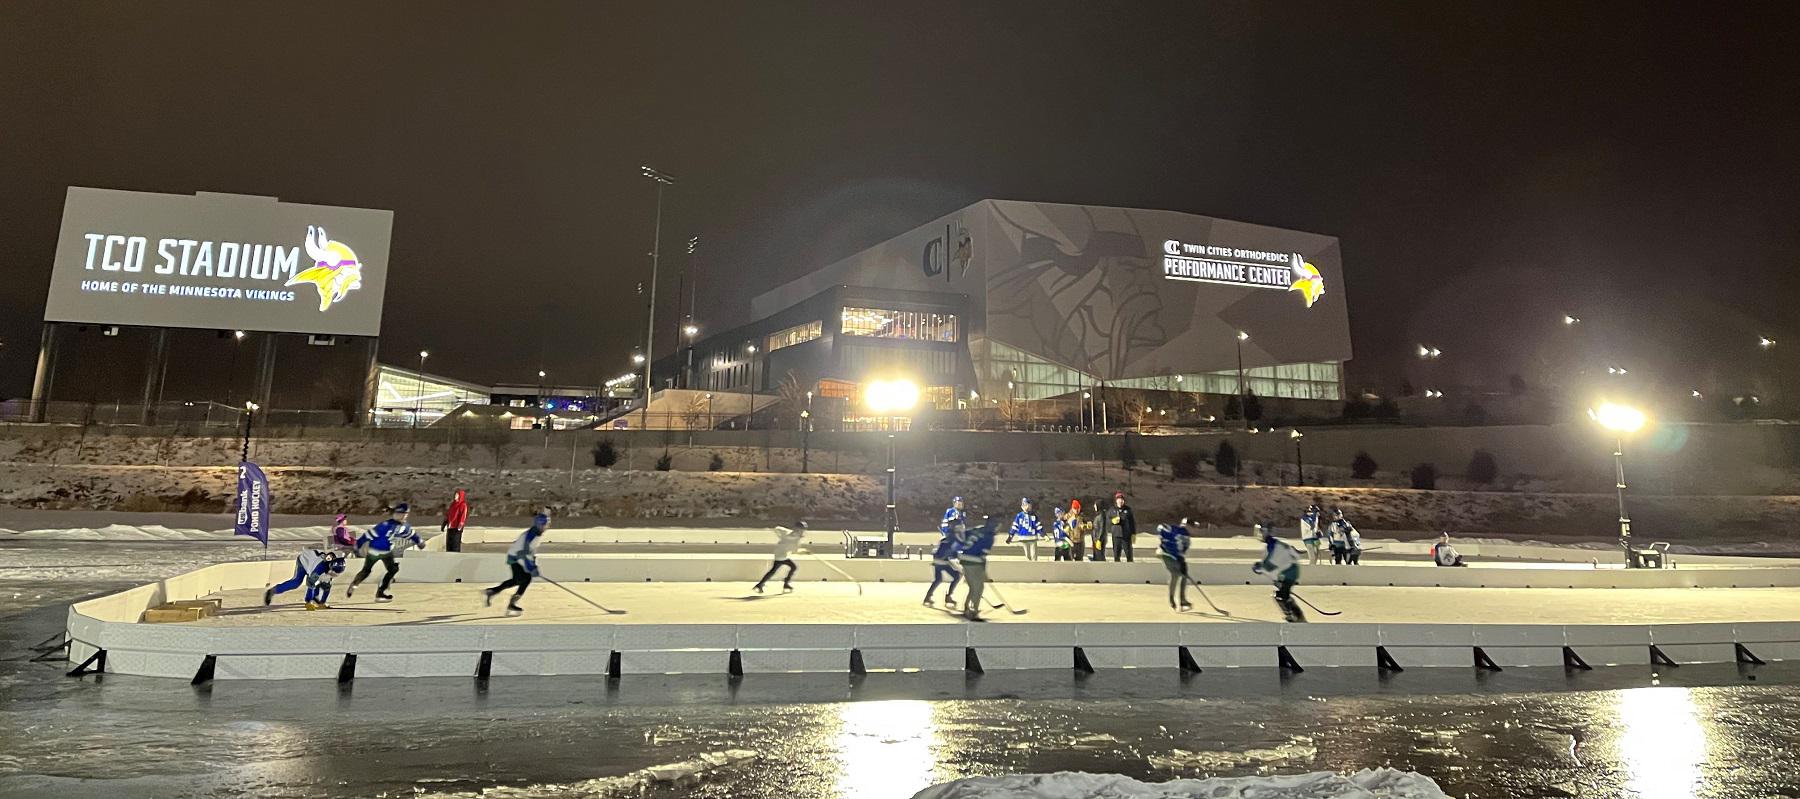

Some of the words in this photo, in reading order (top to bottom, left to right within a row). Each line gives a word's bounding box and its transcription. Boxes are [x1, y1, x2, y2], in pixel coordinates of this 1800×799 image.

[84, 232, 148, 272] TCO
[154, 238, 300, 281] STADIUM
[1183, 243, 1206, 255] TWIN
[1206, 246, 1232, 257] CITIES
[1234, 249, 1289, 262] ORTHOPEDICS
[1164, 258, 1246, 281] PERFORMANCE
[1249, 266, 1292, 286] CENTER
[81, 280, 118, 293] HOME
[121, 282, 139, 293] OF
[141, 283, 167, 295] THE
[169, 285, 243, 299] MINNESOTA
[245, 288, 296, 302] VIKINGS
[240, 466, 246, 478] 2
[252, 480, 260, 510] HOCKEY
[250, 511, 259, 532] POND
